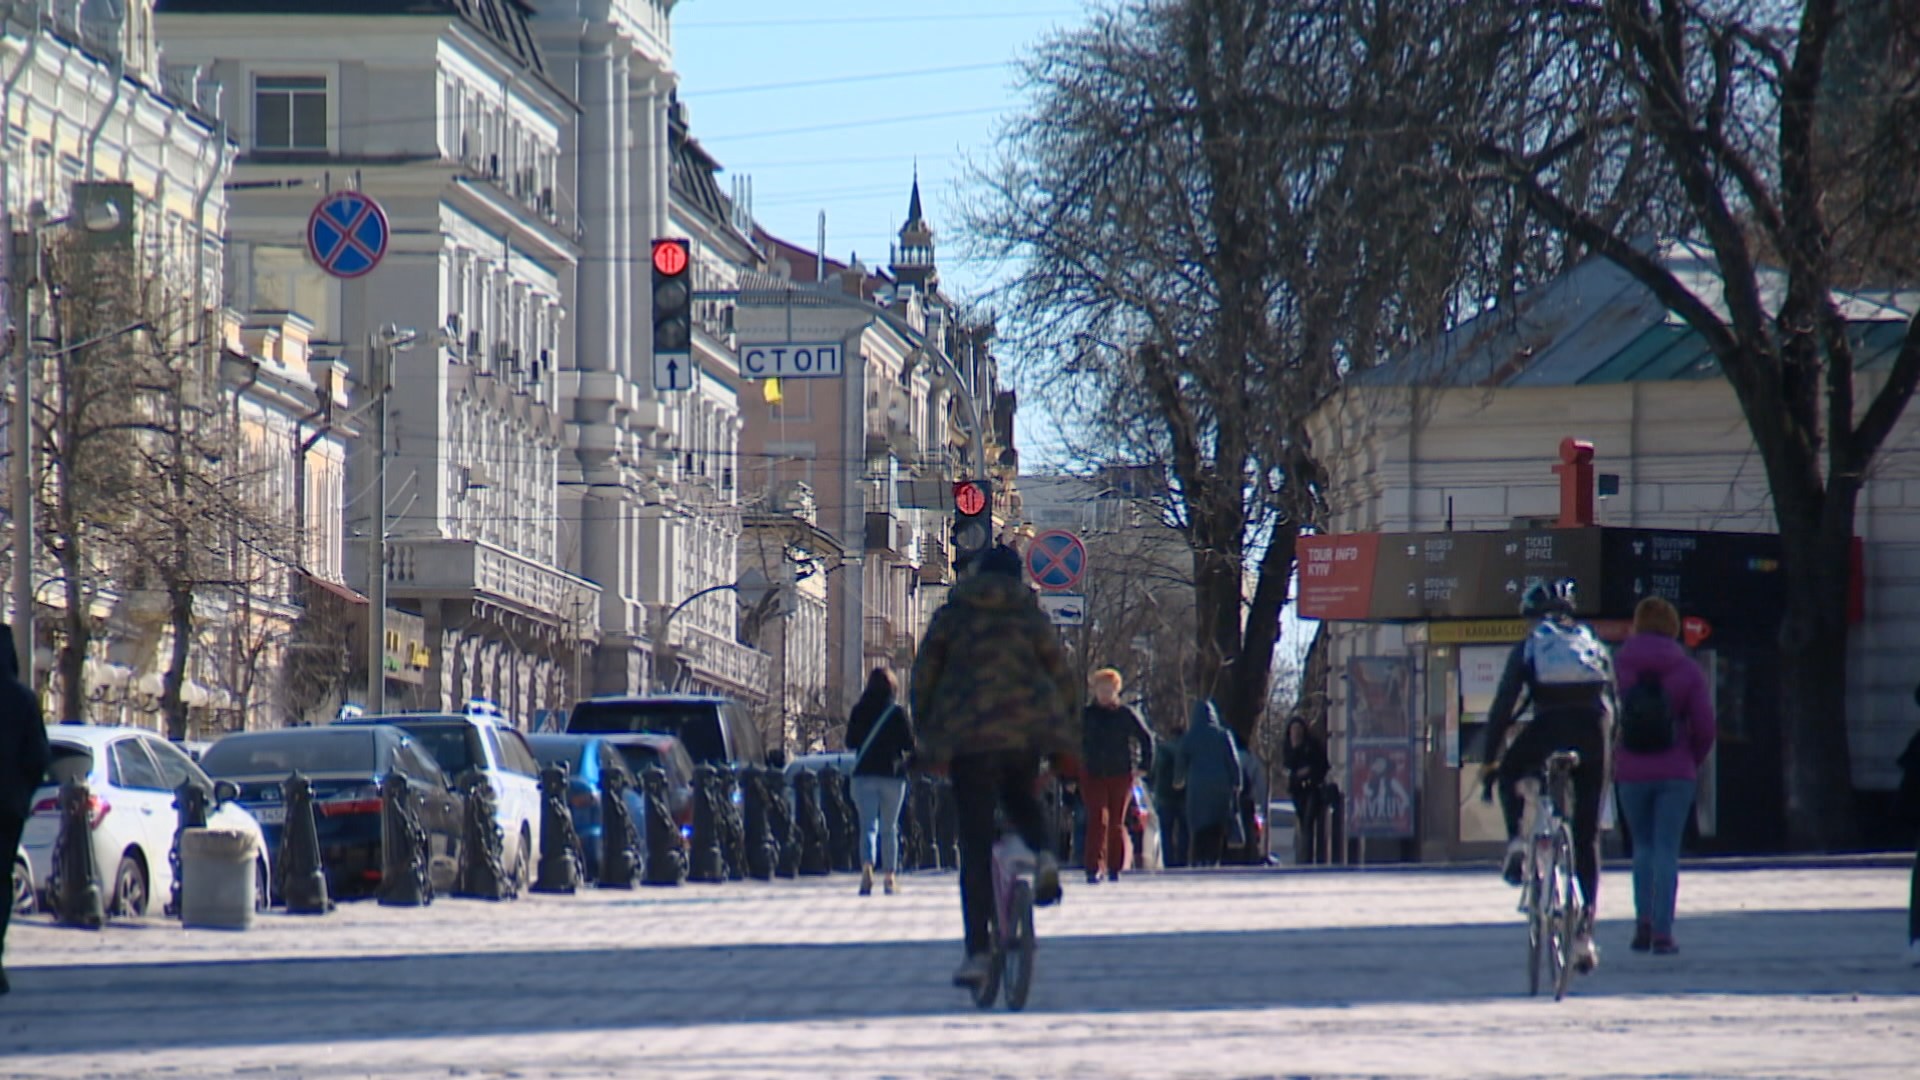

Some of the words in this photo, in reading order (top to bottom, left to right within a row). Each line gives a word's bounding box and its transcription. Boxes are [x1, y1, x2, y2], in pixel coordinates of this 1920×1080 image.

[746, 348, 836, 373] СТОП
[1525, 536, 1552, 548] TICKET
[1307, 547, 1333, 562] TOUR
[1335, 547, 1358, 561] INFO
[1525, 548, 1552, 560] OFFICE
[1307, 563, 1330, 577] KYIV
[1424, 589, 1451, 601] OFFICE
